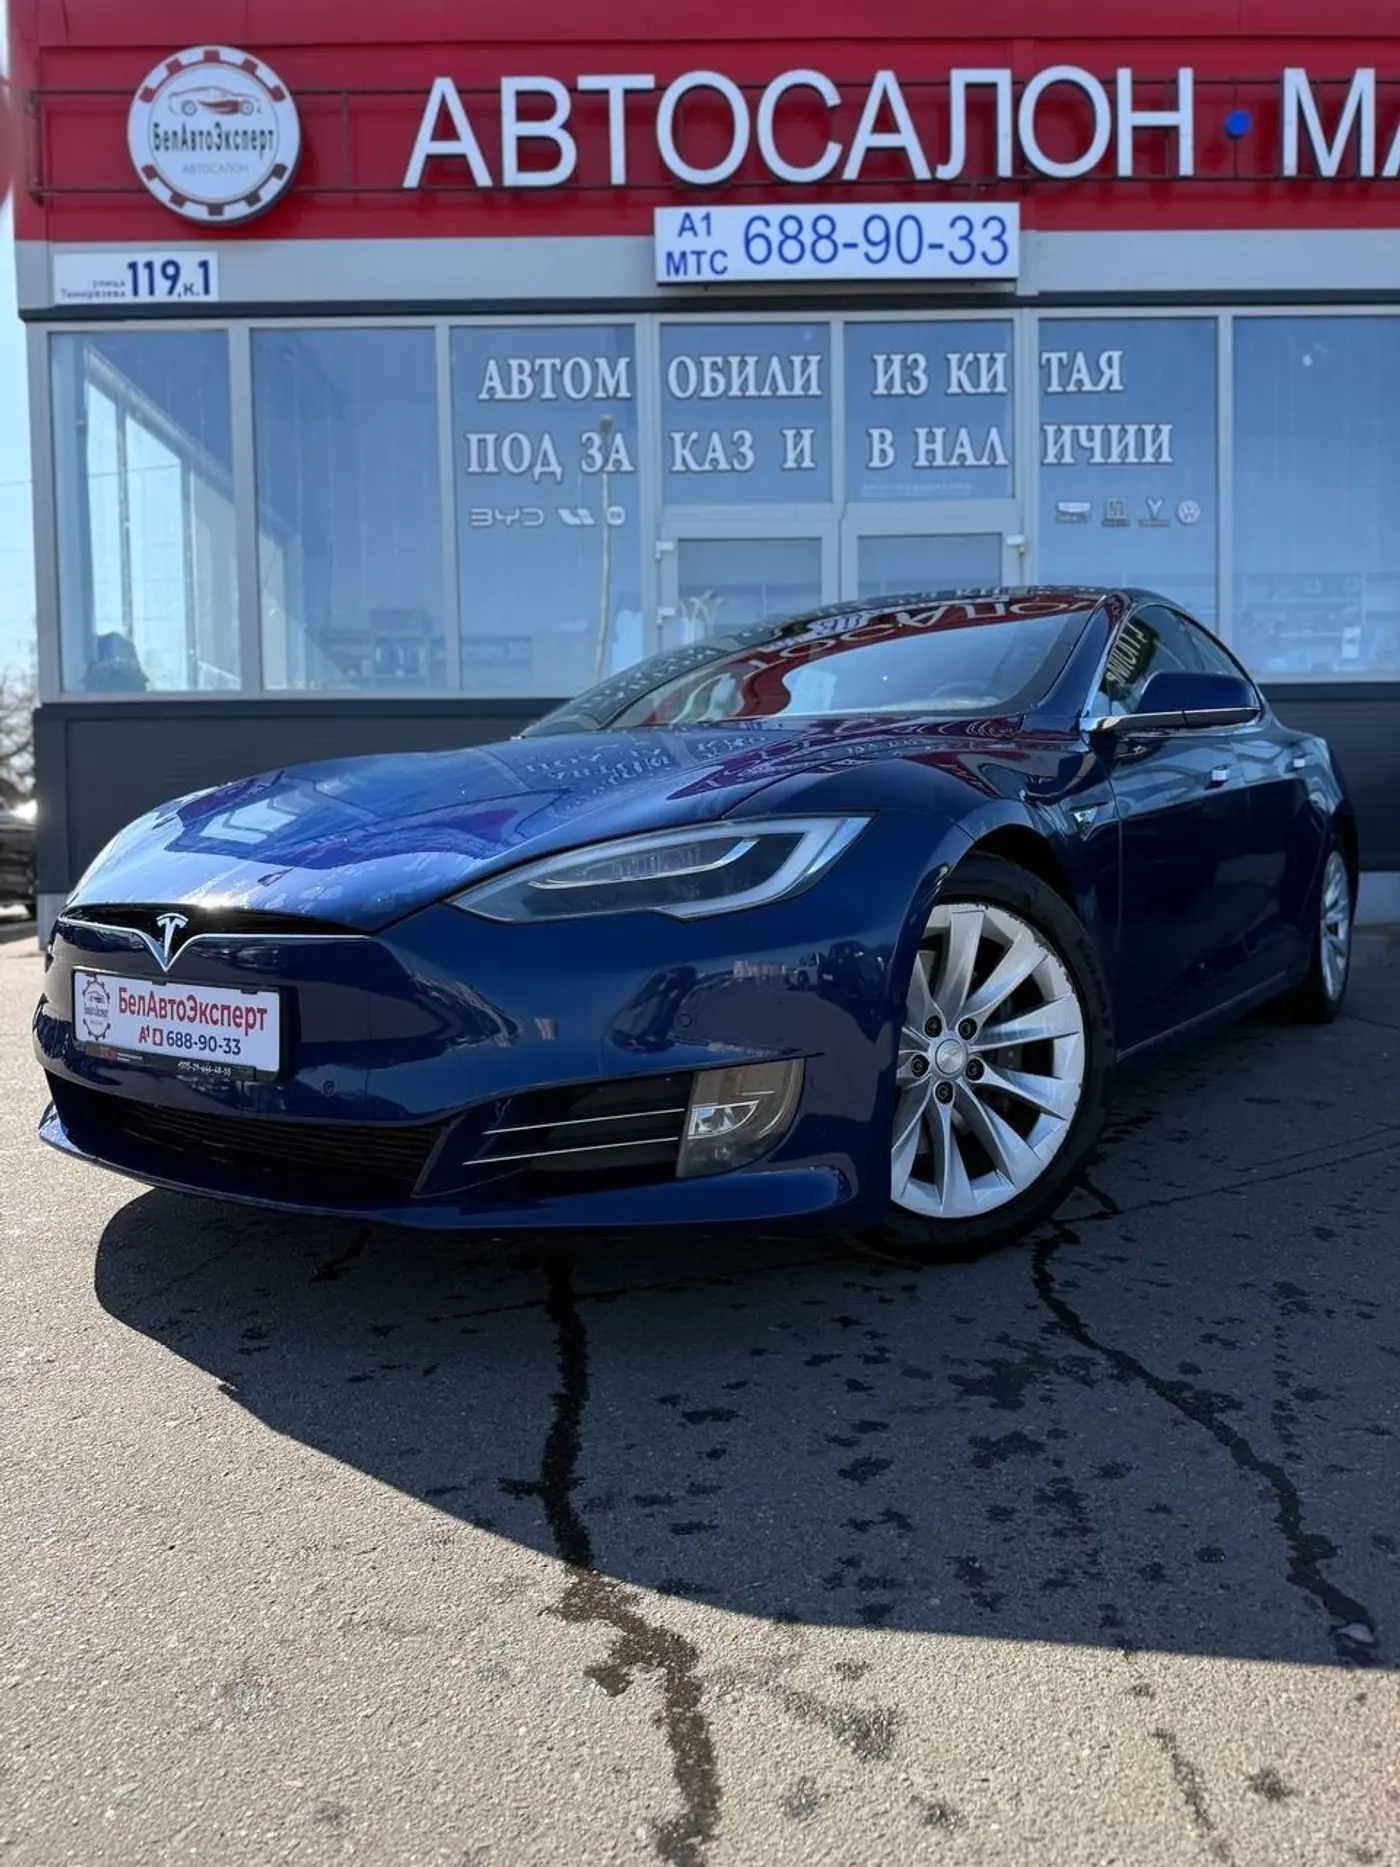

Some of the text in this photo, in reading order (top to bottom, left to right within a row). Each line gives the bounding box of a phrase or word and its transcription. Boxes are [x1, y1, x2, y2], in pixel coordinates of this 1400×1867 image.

[153, 122, 274, 160] БелАвтоЭксперт
[403, 65, 1400, 189] АВТОСАЛОН М
[743, 213, 1010, 267] 688-90-33
[872, 353, 929, 396] ИЗ
[465, 432, 563, 482] ПОД
[782, 428, 816, 470] И
[867, 427, 896, 468] В
[118, 986, 268, 1037] БелАвтоЭксперт
[166, 1030, 242, 1056] 688-90-33
